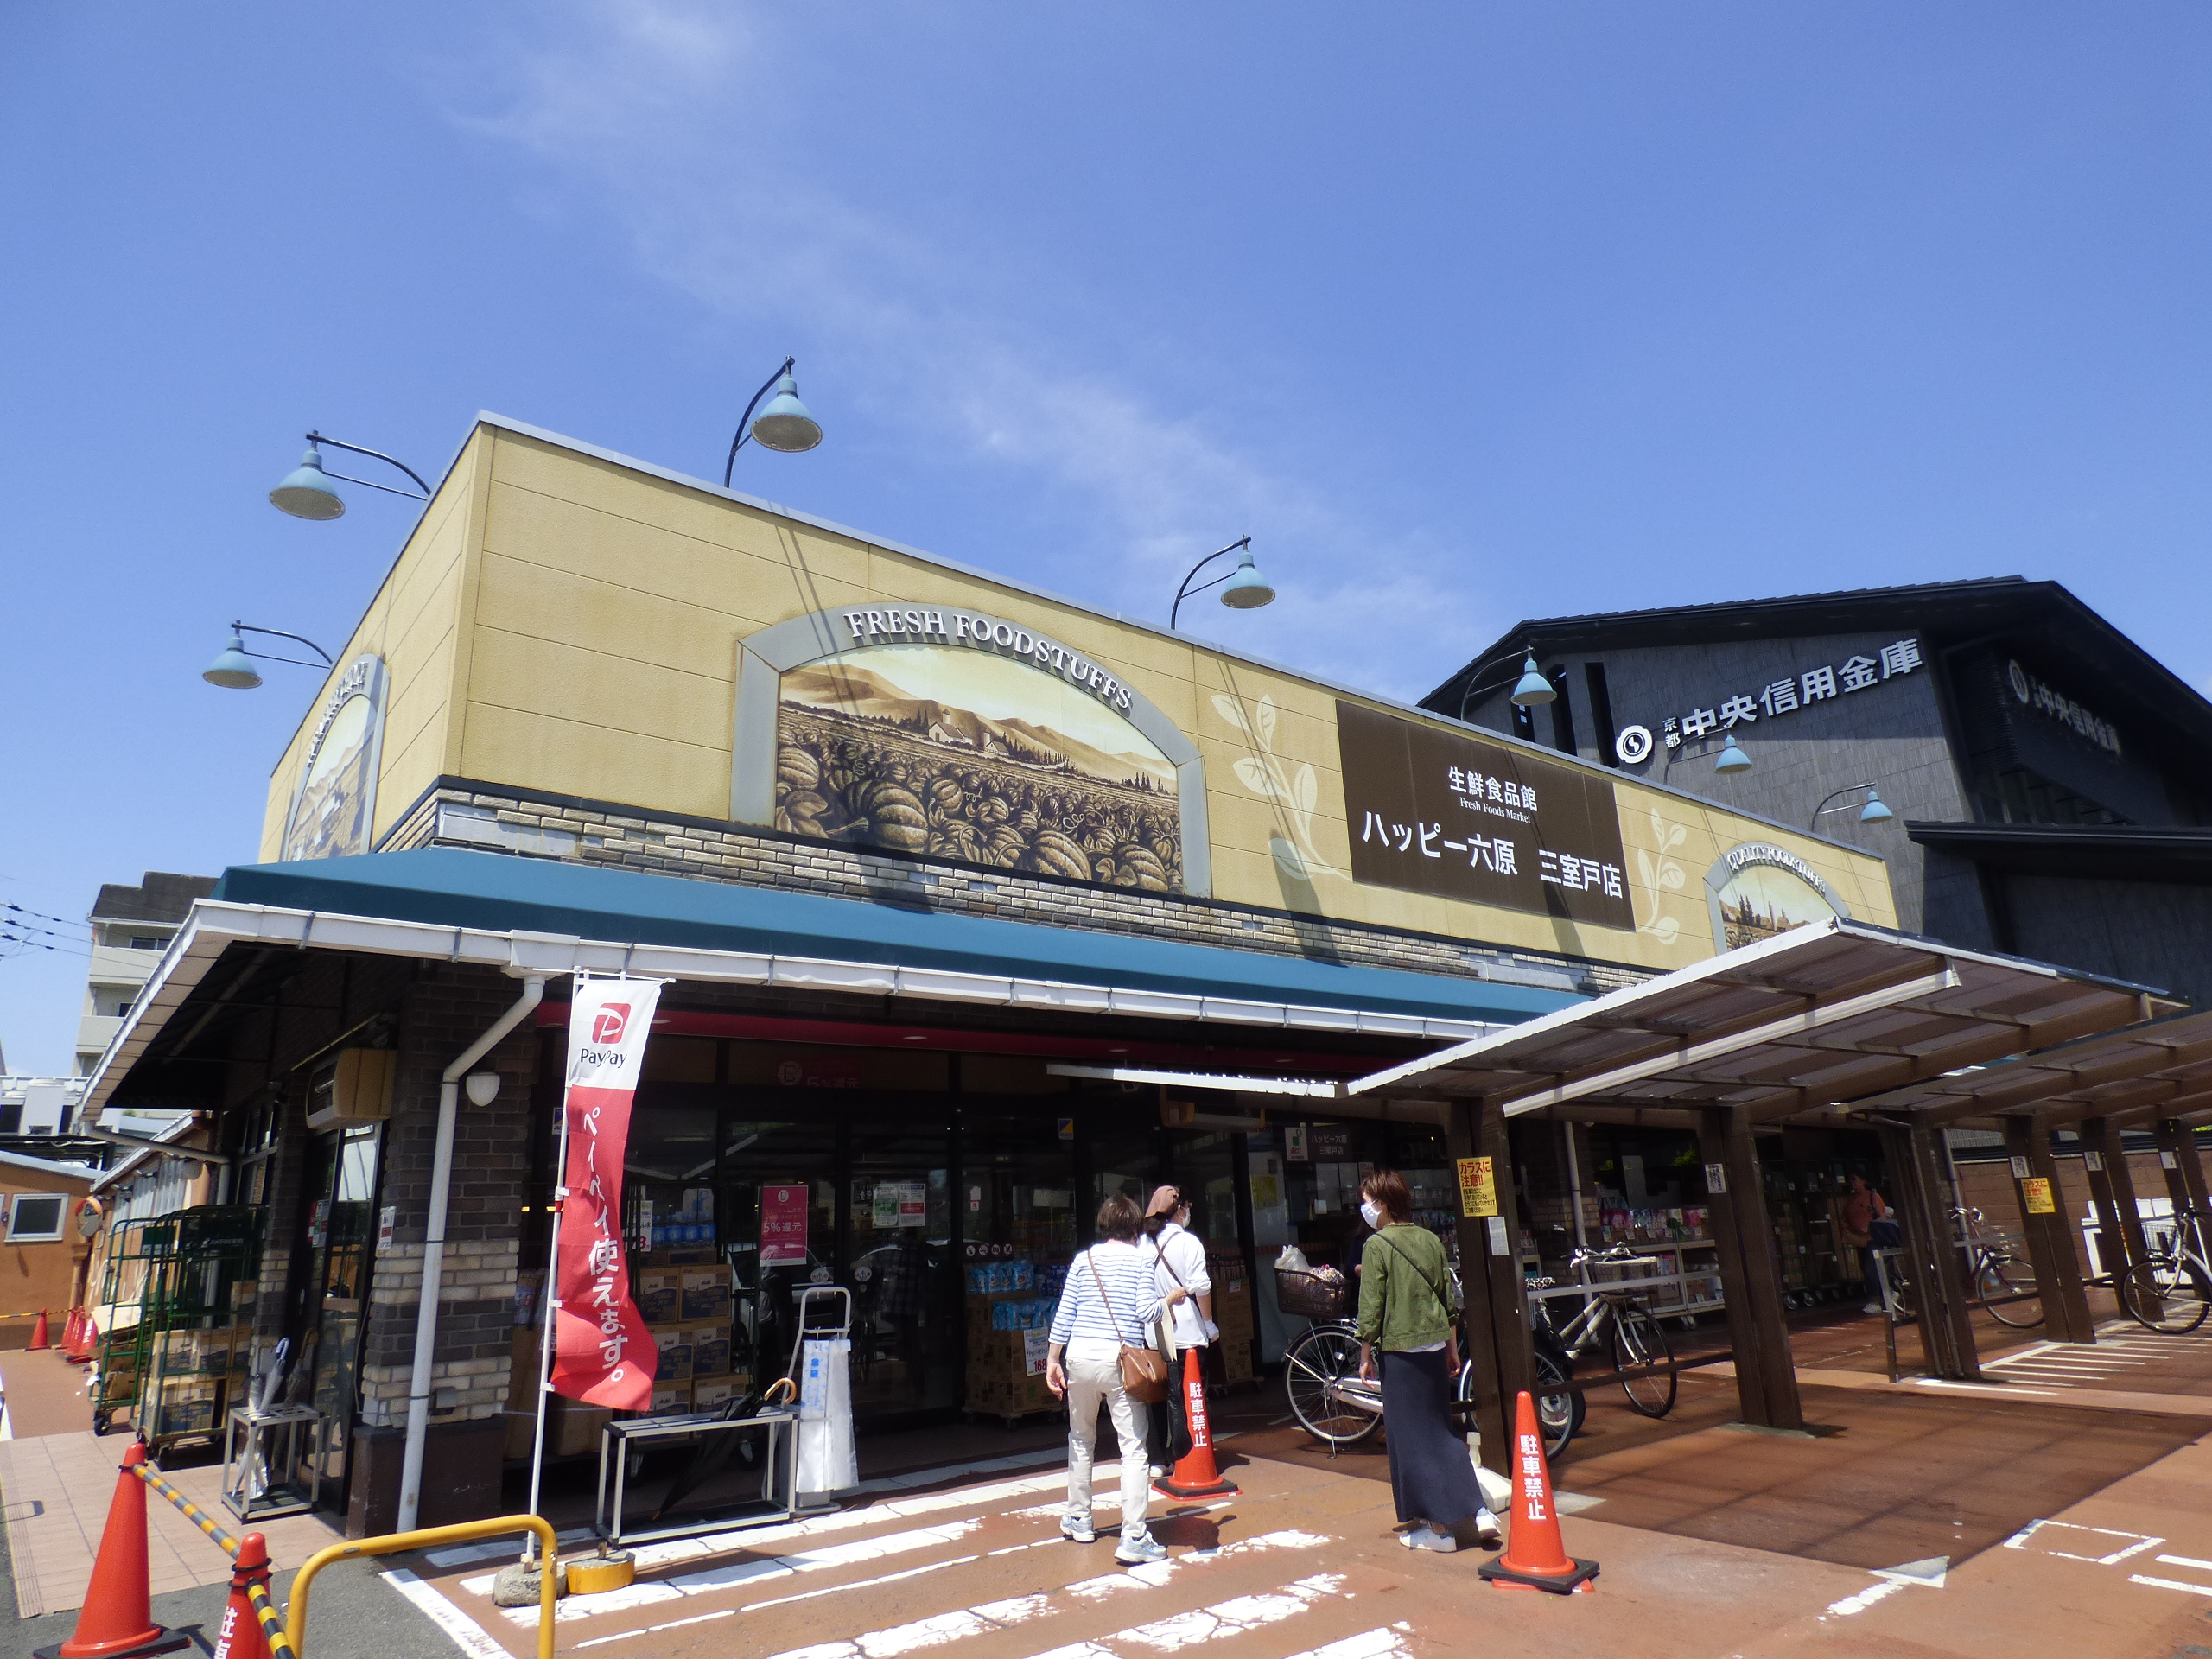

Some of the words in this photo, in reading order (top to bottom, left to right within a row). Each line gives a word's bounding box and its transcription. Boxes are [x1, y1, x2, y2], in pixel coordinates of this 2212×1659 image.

[843, 610, 947, 638] FRESH
[953, 614, 1132, 709] FOODSTUFFS
[1681, 638, 1923, 737] 中央信用金庫
[1662, 716, 1681, 748] 京都
[1448, 766, 1538, 812] 生鮮食品館
[1460, 797, 1481, 811] Fresh
[1484, 803, 1505, 818] Foods
[1506, 809, 1531, 823] Market
[1362, 810, 1518, 876] ハッピー六原
[1538, 849, 1624, 899] 三室戸店
[1727, 846, 1769, 871] QUALITY
[580, 1048, 627, 1068] PayPay
[1459, 1161, 1491, 1175] カラスに
[1189, 1382, 1208, 1447] 駐車禁止
[1520, 1434, 1547, 1521] 駐車禁止
